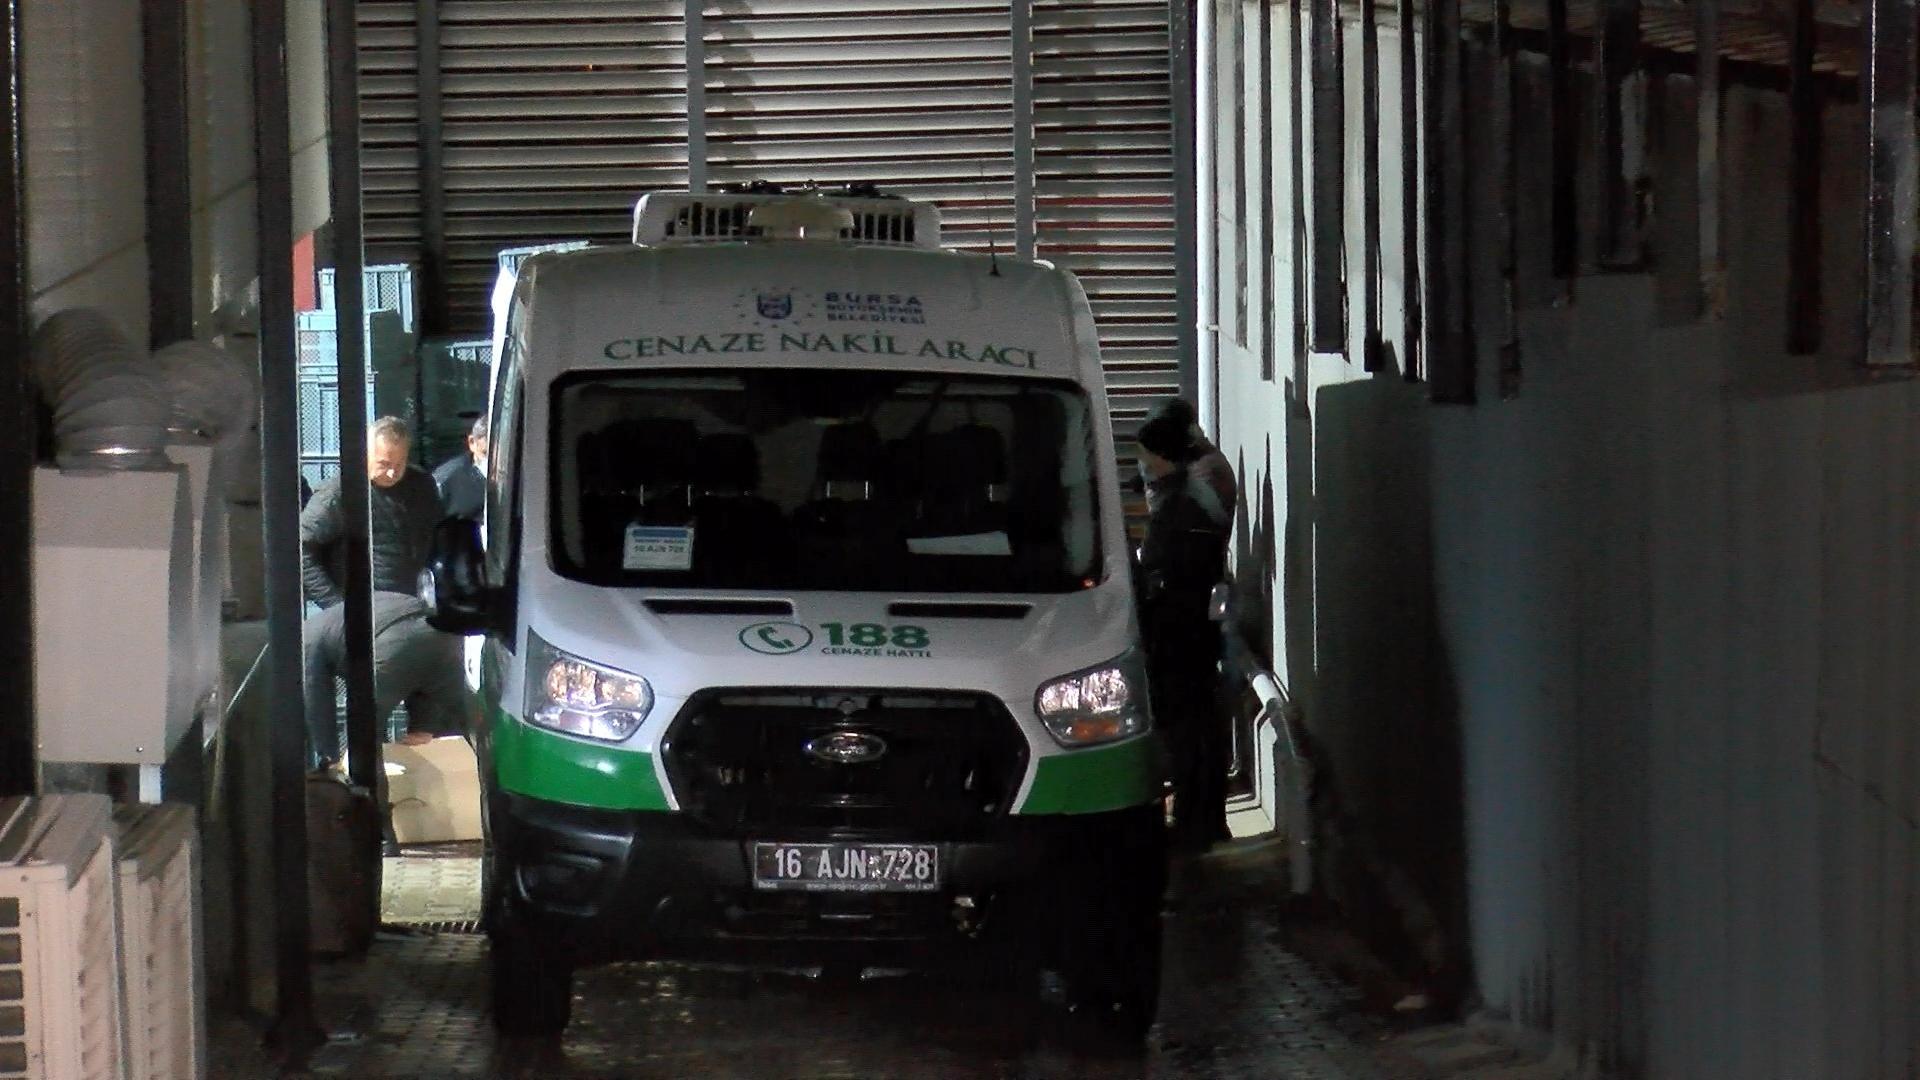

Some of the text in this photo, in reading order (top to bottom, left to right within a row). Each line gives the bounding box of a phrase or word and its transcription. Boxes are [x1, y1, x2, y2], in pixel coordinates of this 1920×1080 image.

[825, 292, 922, 305] BURSA
[603, 329, 1038, 370] CENAZE NAKİL ARACI
[819, 622, 931, 649] 188
[820, 647, 932, 658] CENAZE HATTI
[775, 848, 931, 880] 16 AJN 728
